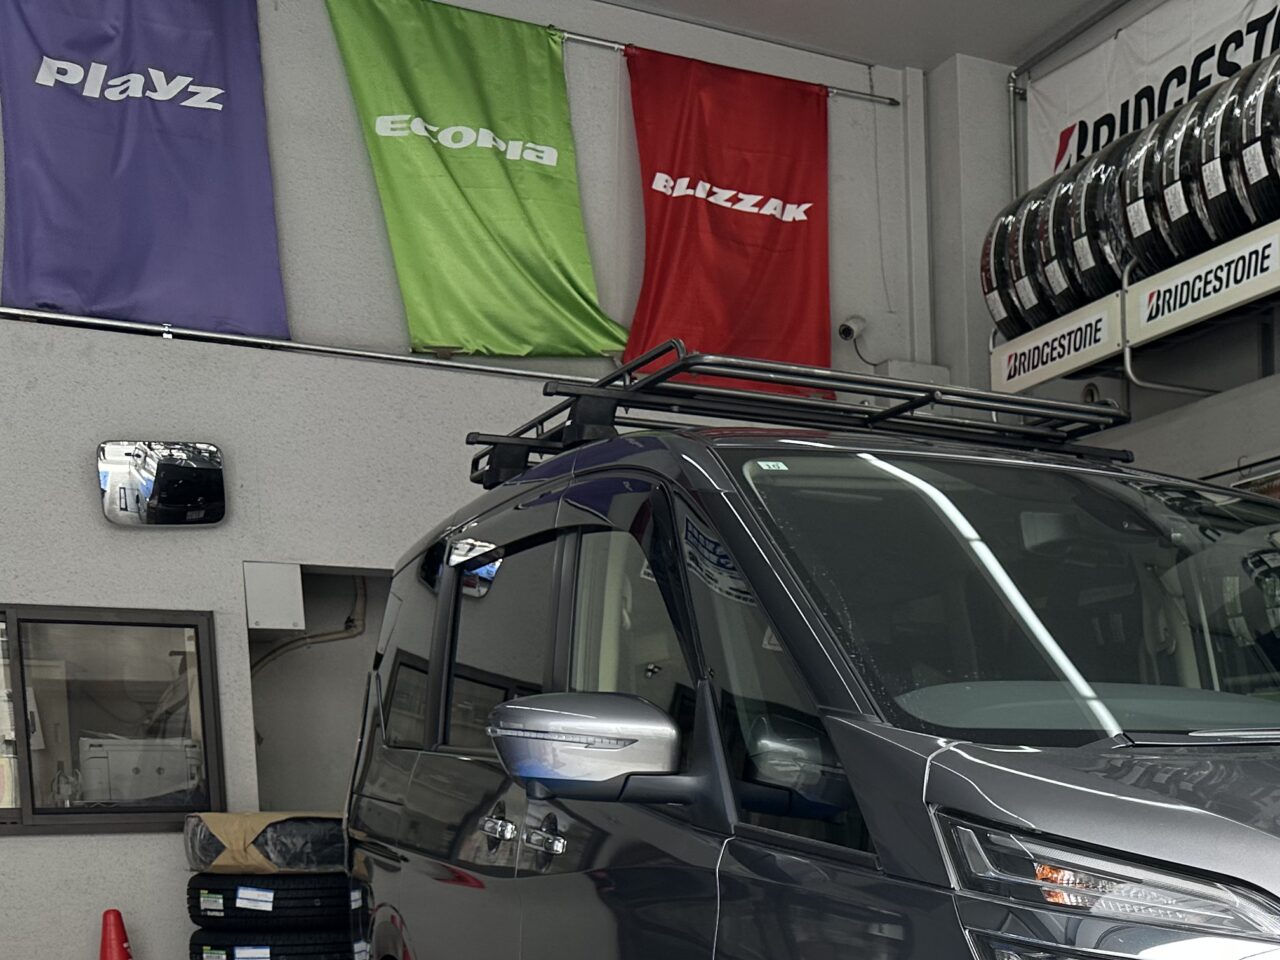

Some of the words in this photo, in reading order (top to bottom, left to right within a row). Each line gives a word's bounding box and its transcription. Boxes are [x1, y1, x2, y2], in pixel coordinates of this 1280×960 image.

[651, 170, 814, 224] BLIZZAK
[1145, 242, 1273, 324] BRIDGESTONE
[1006, 316, 1103, 382] BRIDGESTONE
